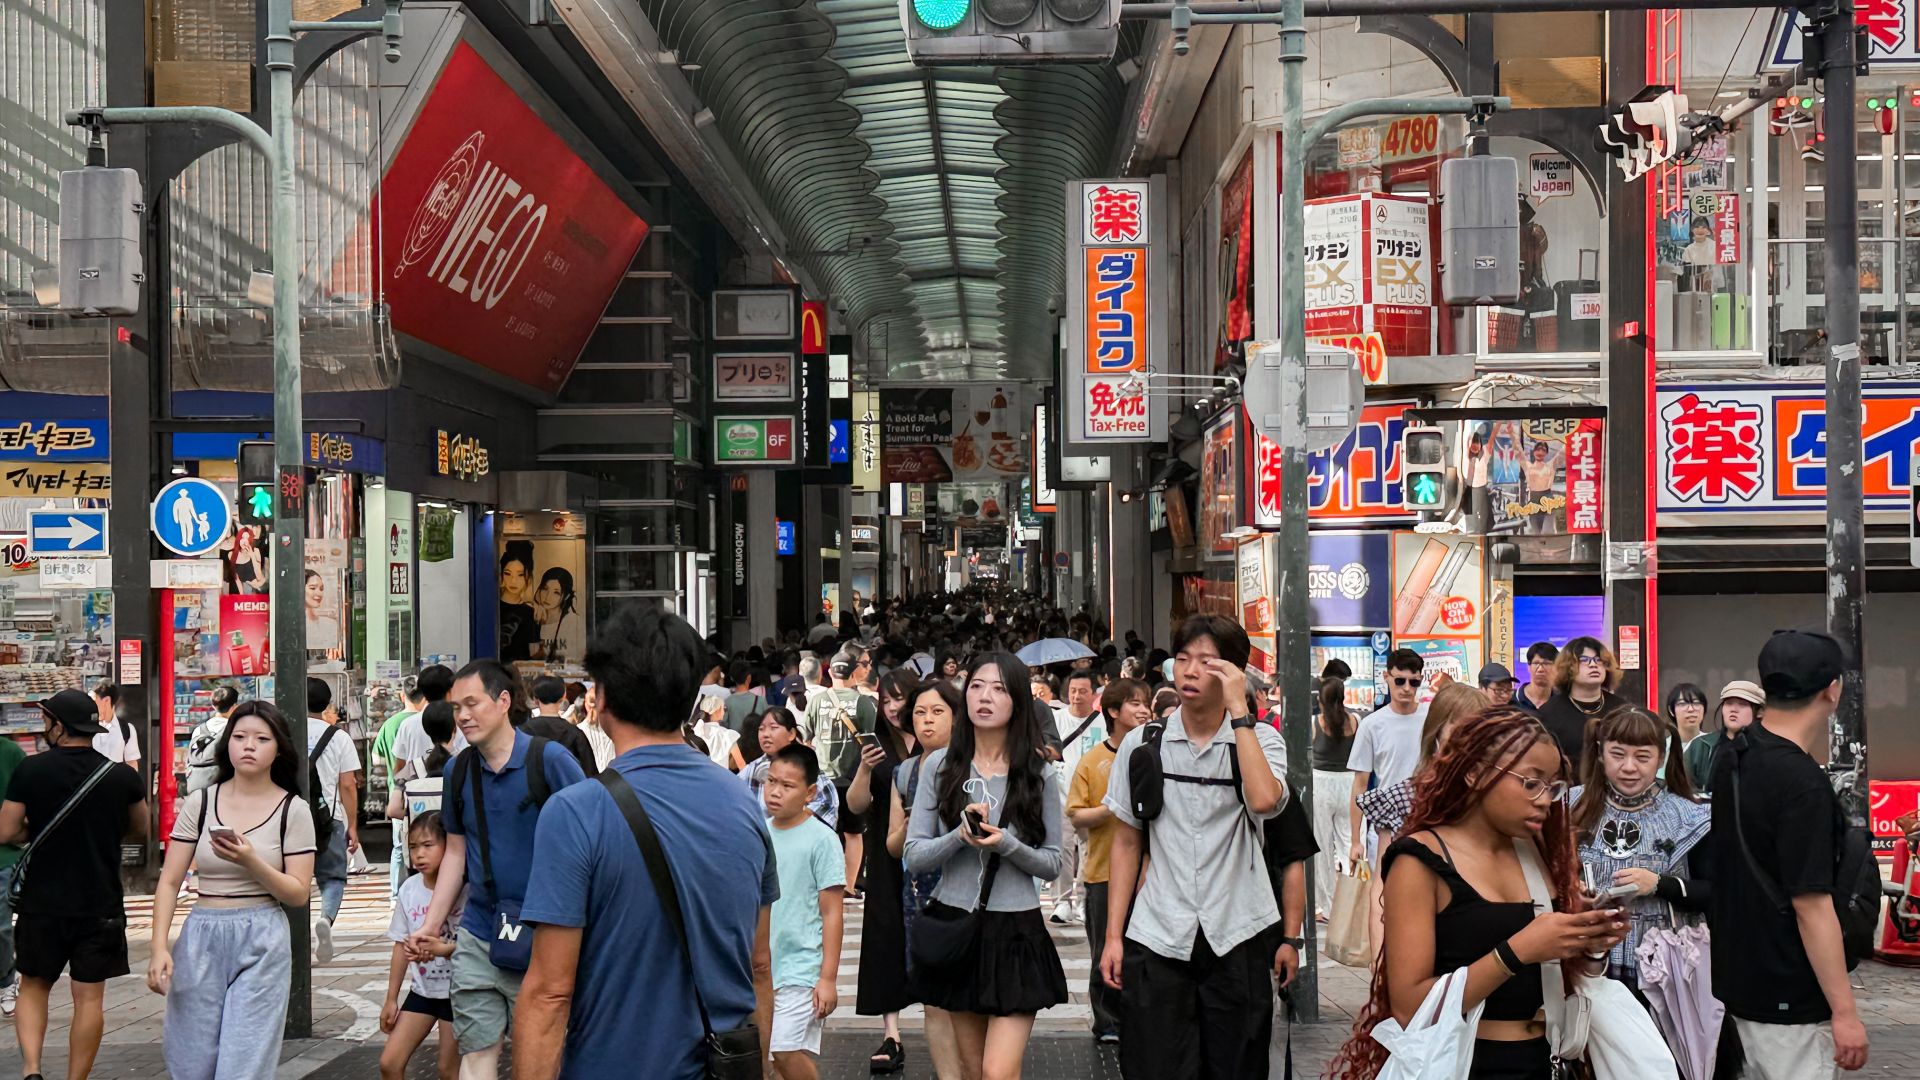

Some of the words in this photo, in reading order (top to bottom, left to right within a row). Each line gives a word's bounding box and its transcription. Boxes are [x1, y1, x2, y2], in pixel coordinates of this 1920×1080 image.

[1385, 115, 1439, 157] 4780
[1532, 159, 1571, 171] Welcome
[1546, 172, 1557, 180] to
[1532, 180, 1571, 194] Japan
[1695, 195, 1712, 205] 2F
[1698, 205, 1715, 214] 3F
[1091, 186, 1141, 241] 薬
[427, 160, 548, 310] WEGO
[1718, 194, 1736, 263] 打卡景点
[1376, 238, 1422, 258] アリナミン
[1376, 257, 1422, 286] EX
[1386, 281, 1427, 304] PLUS
[1096, 252, 1136, 369] ダイコク
[1089, 381, 1145, 417] 免税
[1089, 418, 1146, 433] Tax-Free
[1529, 419, 1551, 434] 2F
[1553, 419, 1575, 434] 3F
[0, 423, 94, 454] モトキヨシ
[768, 435, 787, 447] 6F
[1664, 394, 1761, 499] 薬
[1571, 432, 1598, 529] 打卡景点
[1443, 600, 1468, 611] NOW
[1448, 607, 1466, 618] ON
[1446, 614, 1473, 626] SALE!
